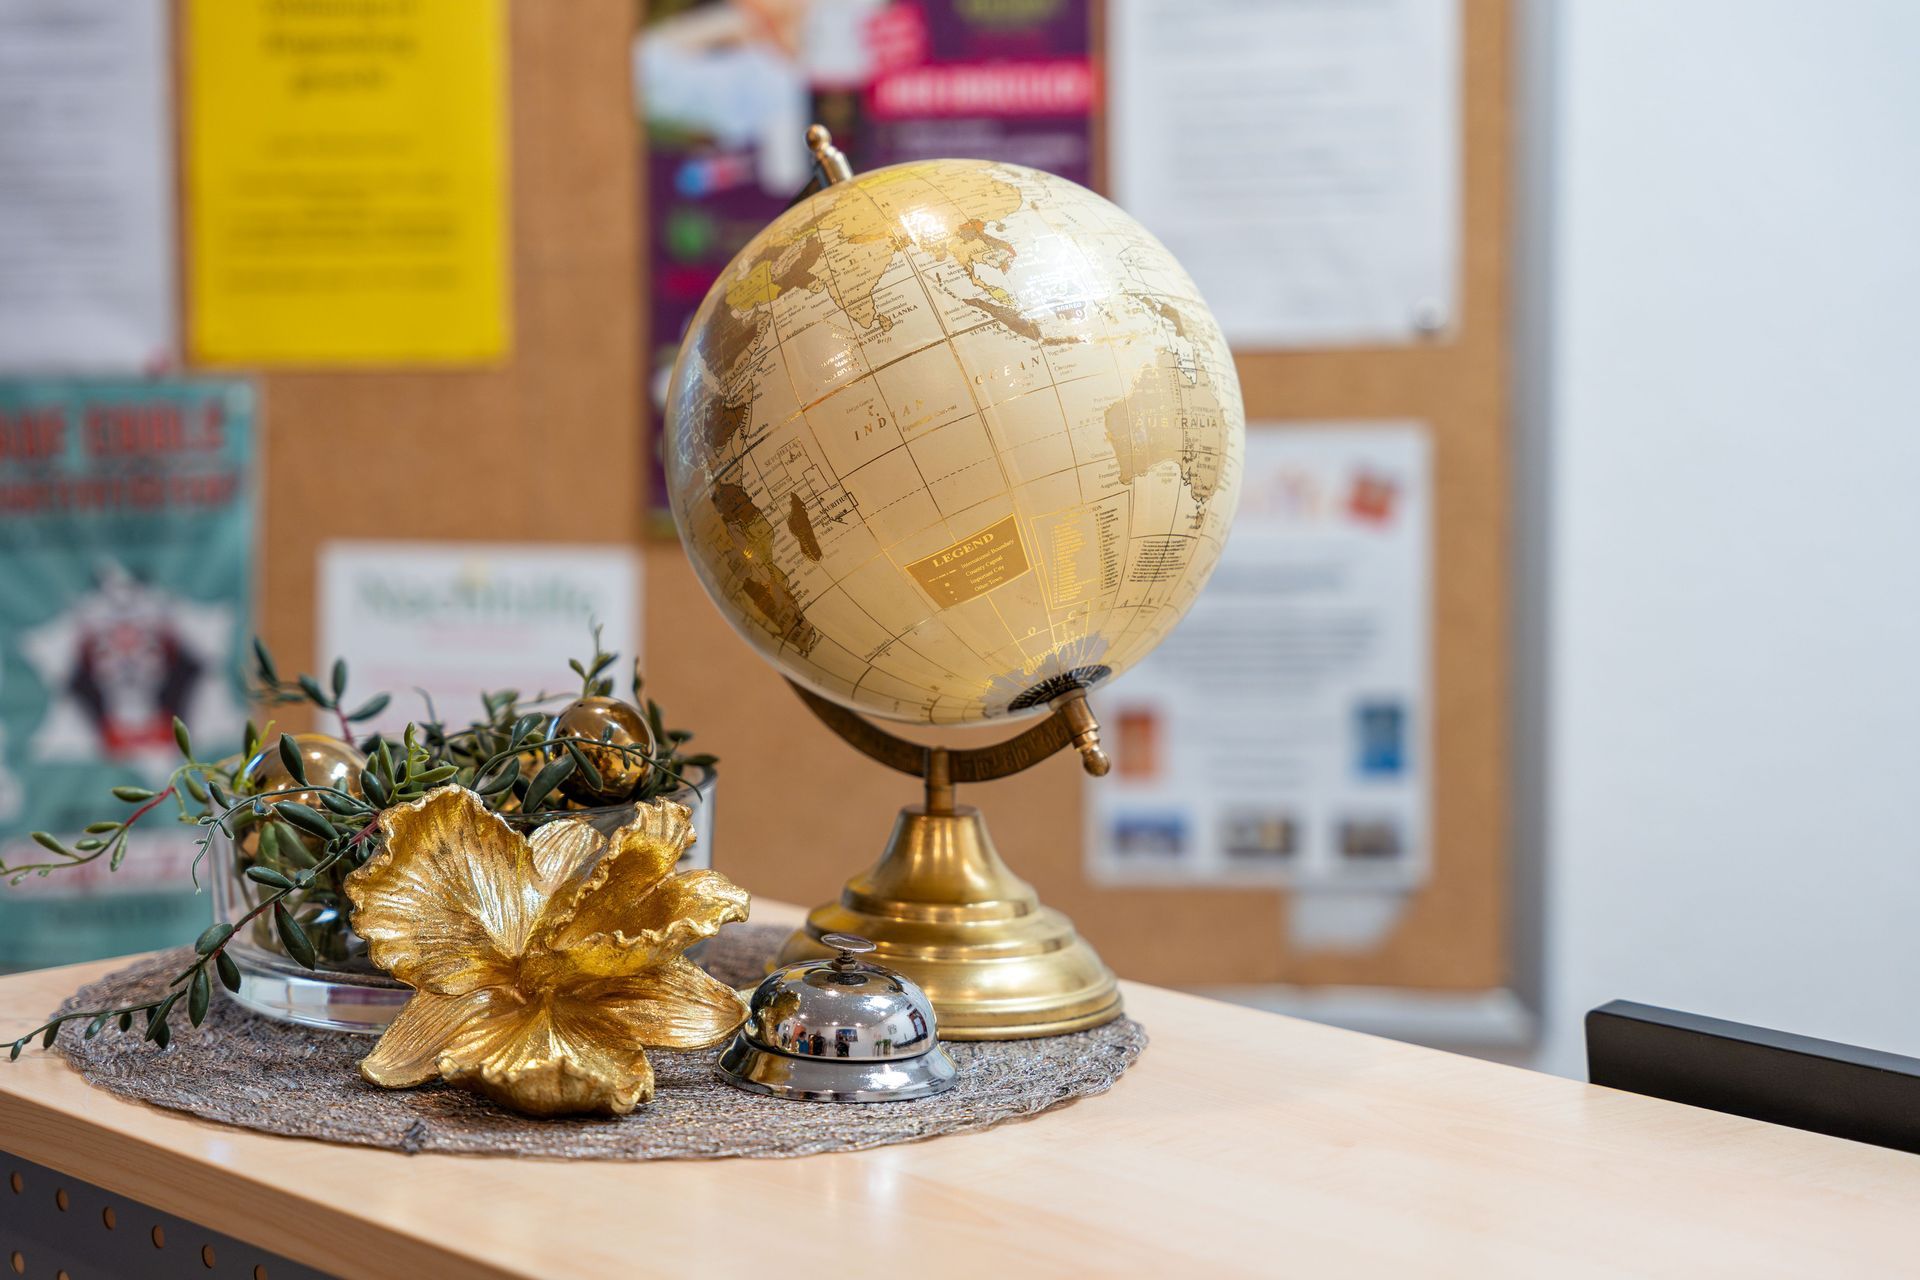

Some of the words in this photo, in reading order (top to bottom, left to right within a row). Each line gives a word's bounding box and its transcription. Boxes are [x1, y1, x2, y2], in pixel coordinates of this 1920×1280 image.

[892, 304, 918, 320] LANKA
[854, 398, 924, 441] INDIAN
[1135, 417, 1217, 429] AUSTRALIA
[932, 533, 994, 568] LEGEND
[961, 551, 991, 569] International
[990, 539, 1015, 554] Boundary
[965, 564, 985, 577] Country
[985, 555, 1003, 567] Capital
